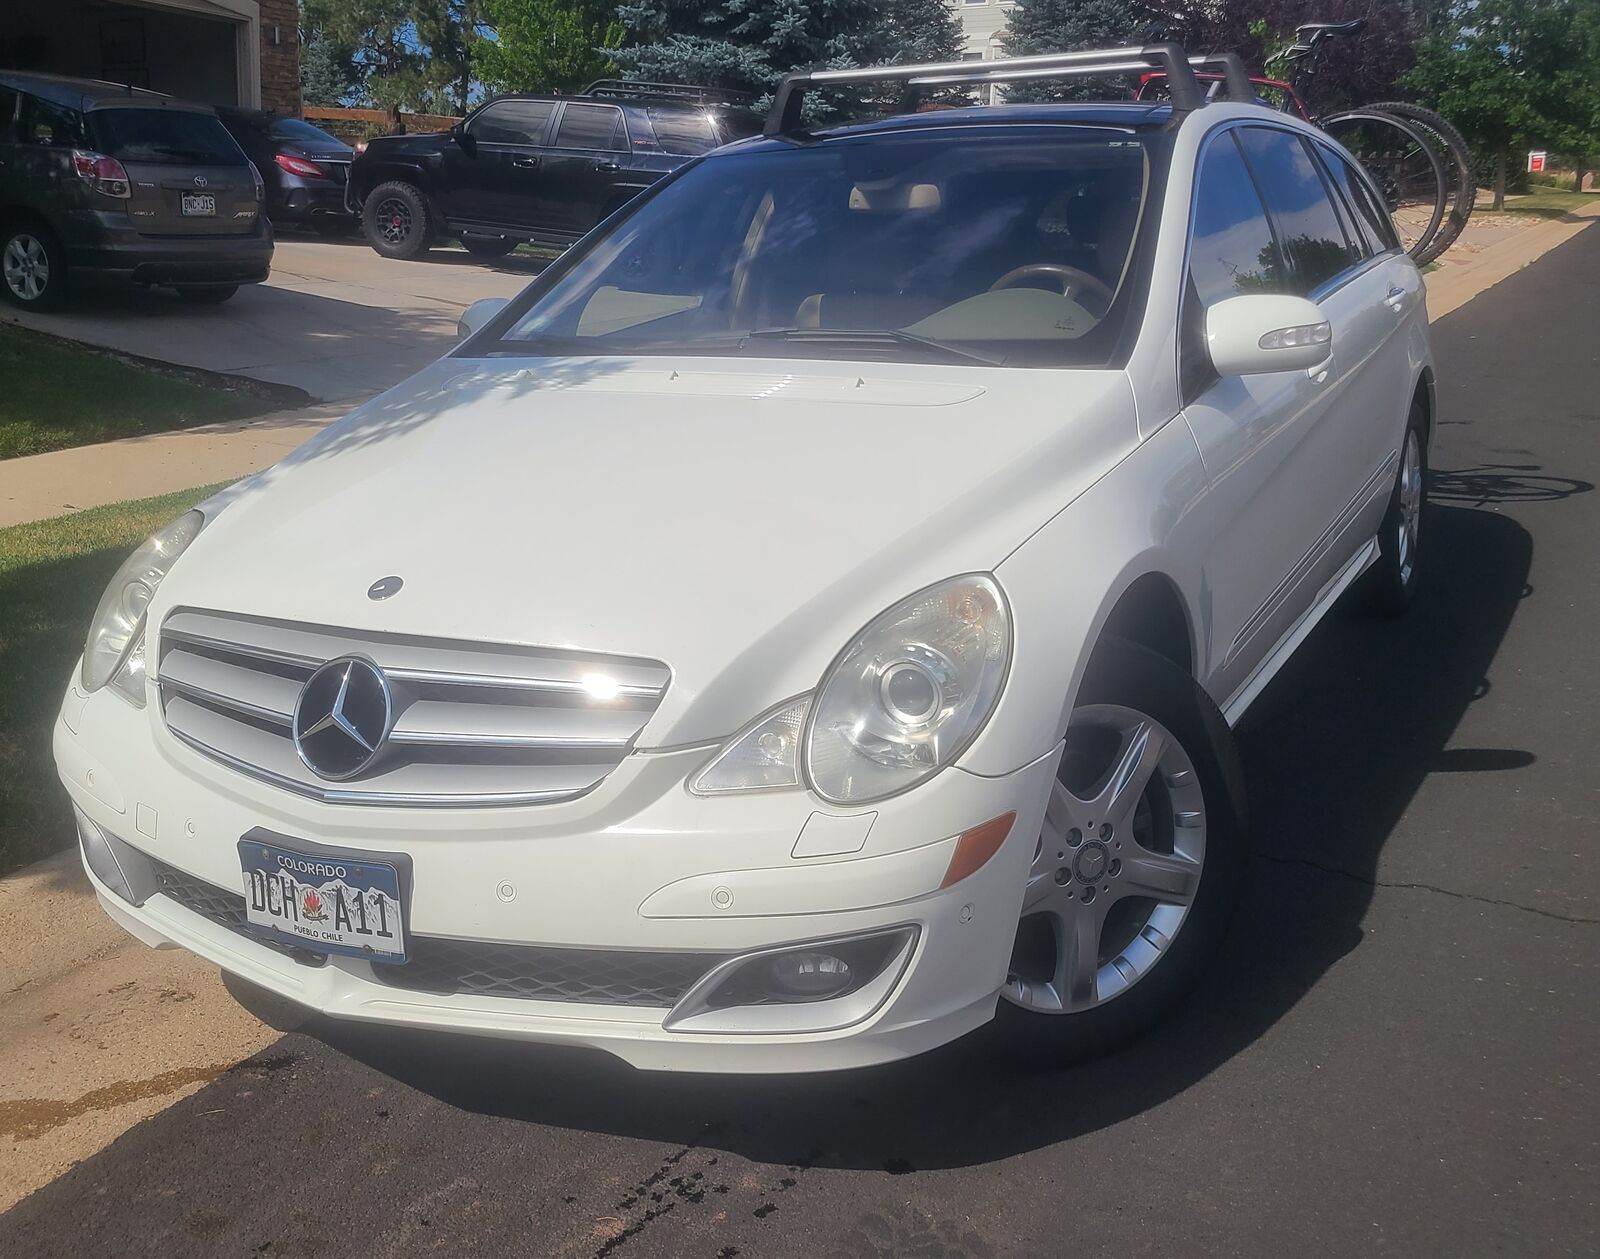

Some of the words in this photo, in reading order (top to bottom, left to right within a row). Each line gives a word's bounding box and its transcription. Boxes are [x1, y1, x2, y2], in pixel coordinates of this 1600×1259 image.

[277, 855, 347, 878] COLORADO
[251, 869, 299, 922] DCH
[335, 885, 393, 938] A11
[293, 924, 319, 938] PUEBLO
[321, 932, 343, 942] CHILE
